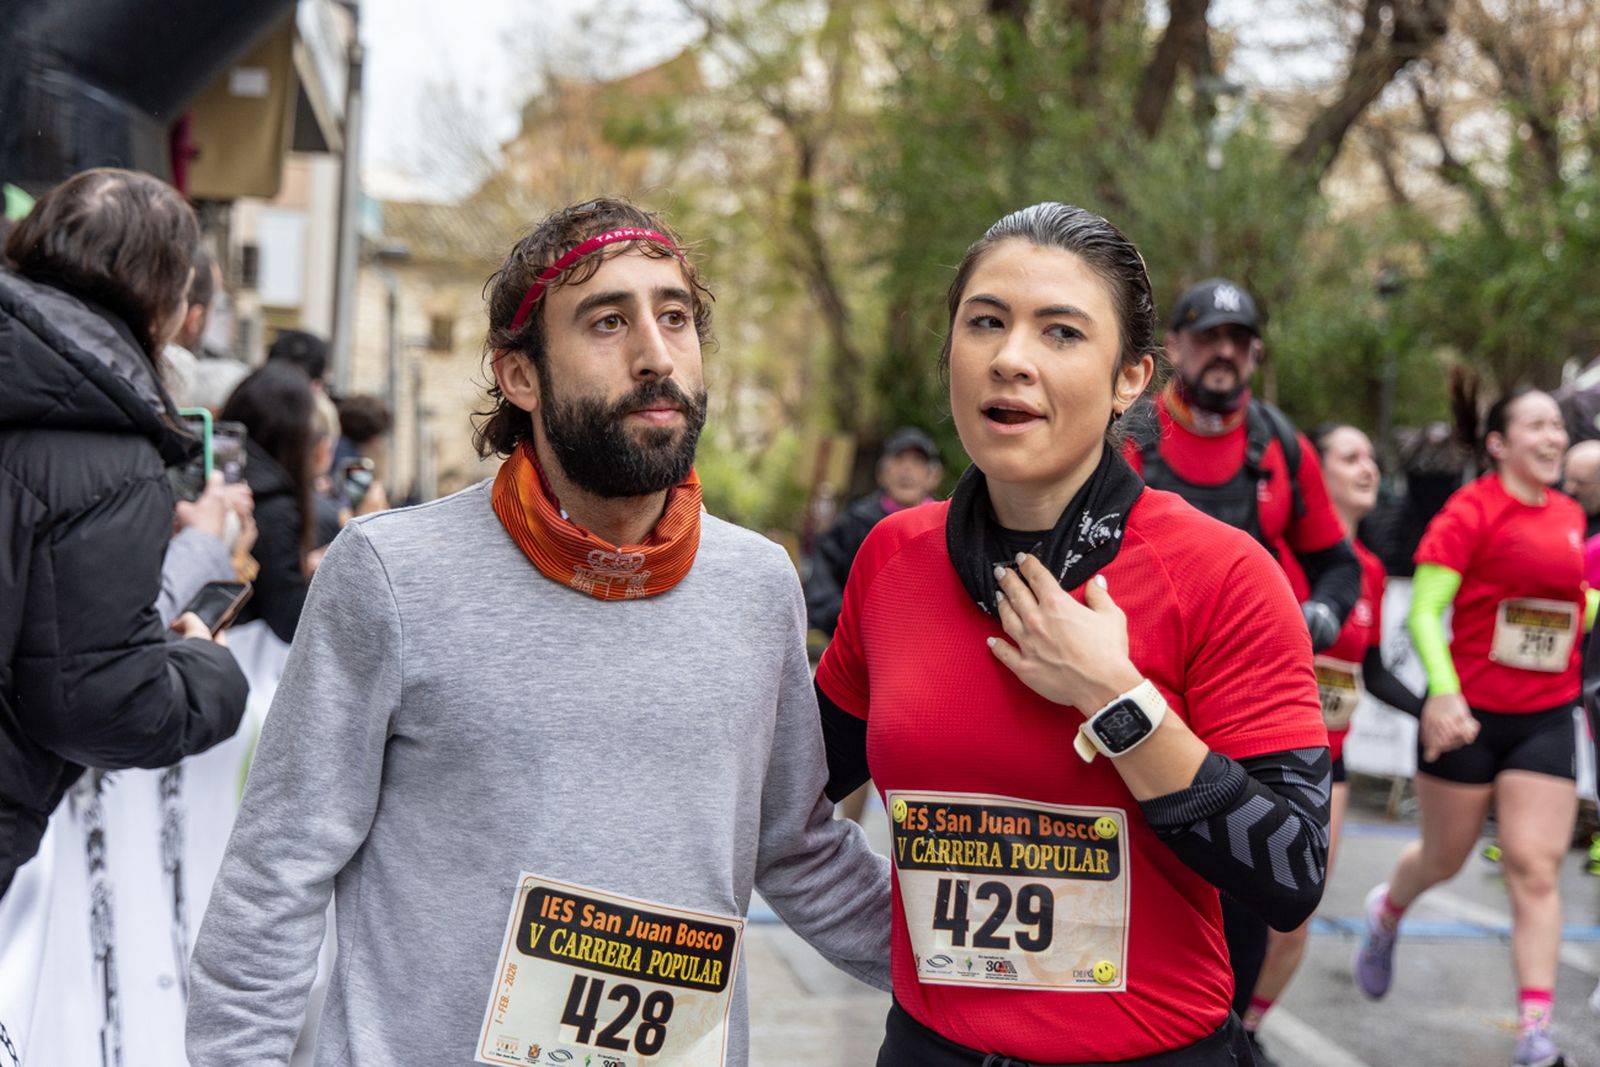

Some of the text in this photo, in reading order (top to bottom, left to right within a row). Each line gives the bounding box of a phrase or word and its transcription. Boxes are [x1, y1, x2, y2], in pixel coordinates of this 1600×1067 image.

[596, 230, 653, 242] TARMAK
[934, 808, 971, 833] San
[978, 810, 1031, 836] Juan
[1038, 815, 1100, 841] Bosco
[897, 836, 1110, 874] V CARRERA POPULAR
[540, 894, 722, 951] IES San Juan Bosco
[932, 878, 1054, 952] 429
[530, 922, 722, 986] V CARRERA POPULAR
[560, 974, 674, 1056] 428
